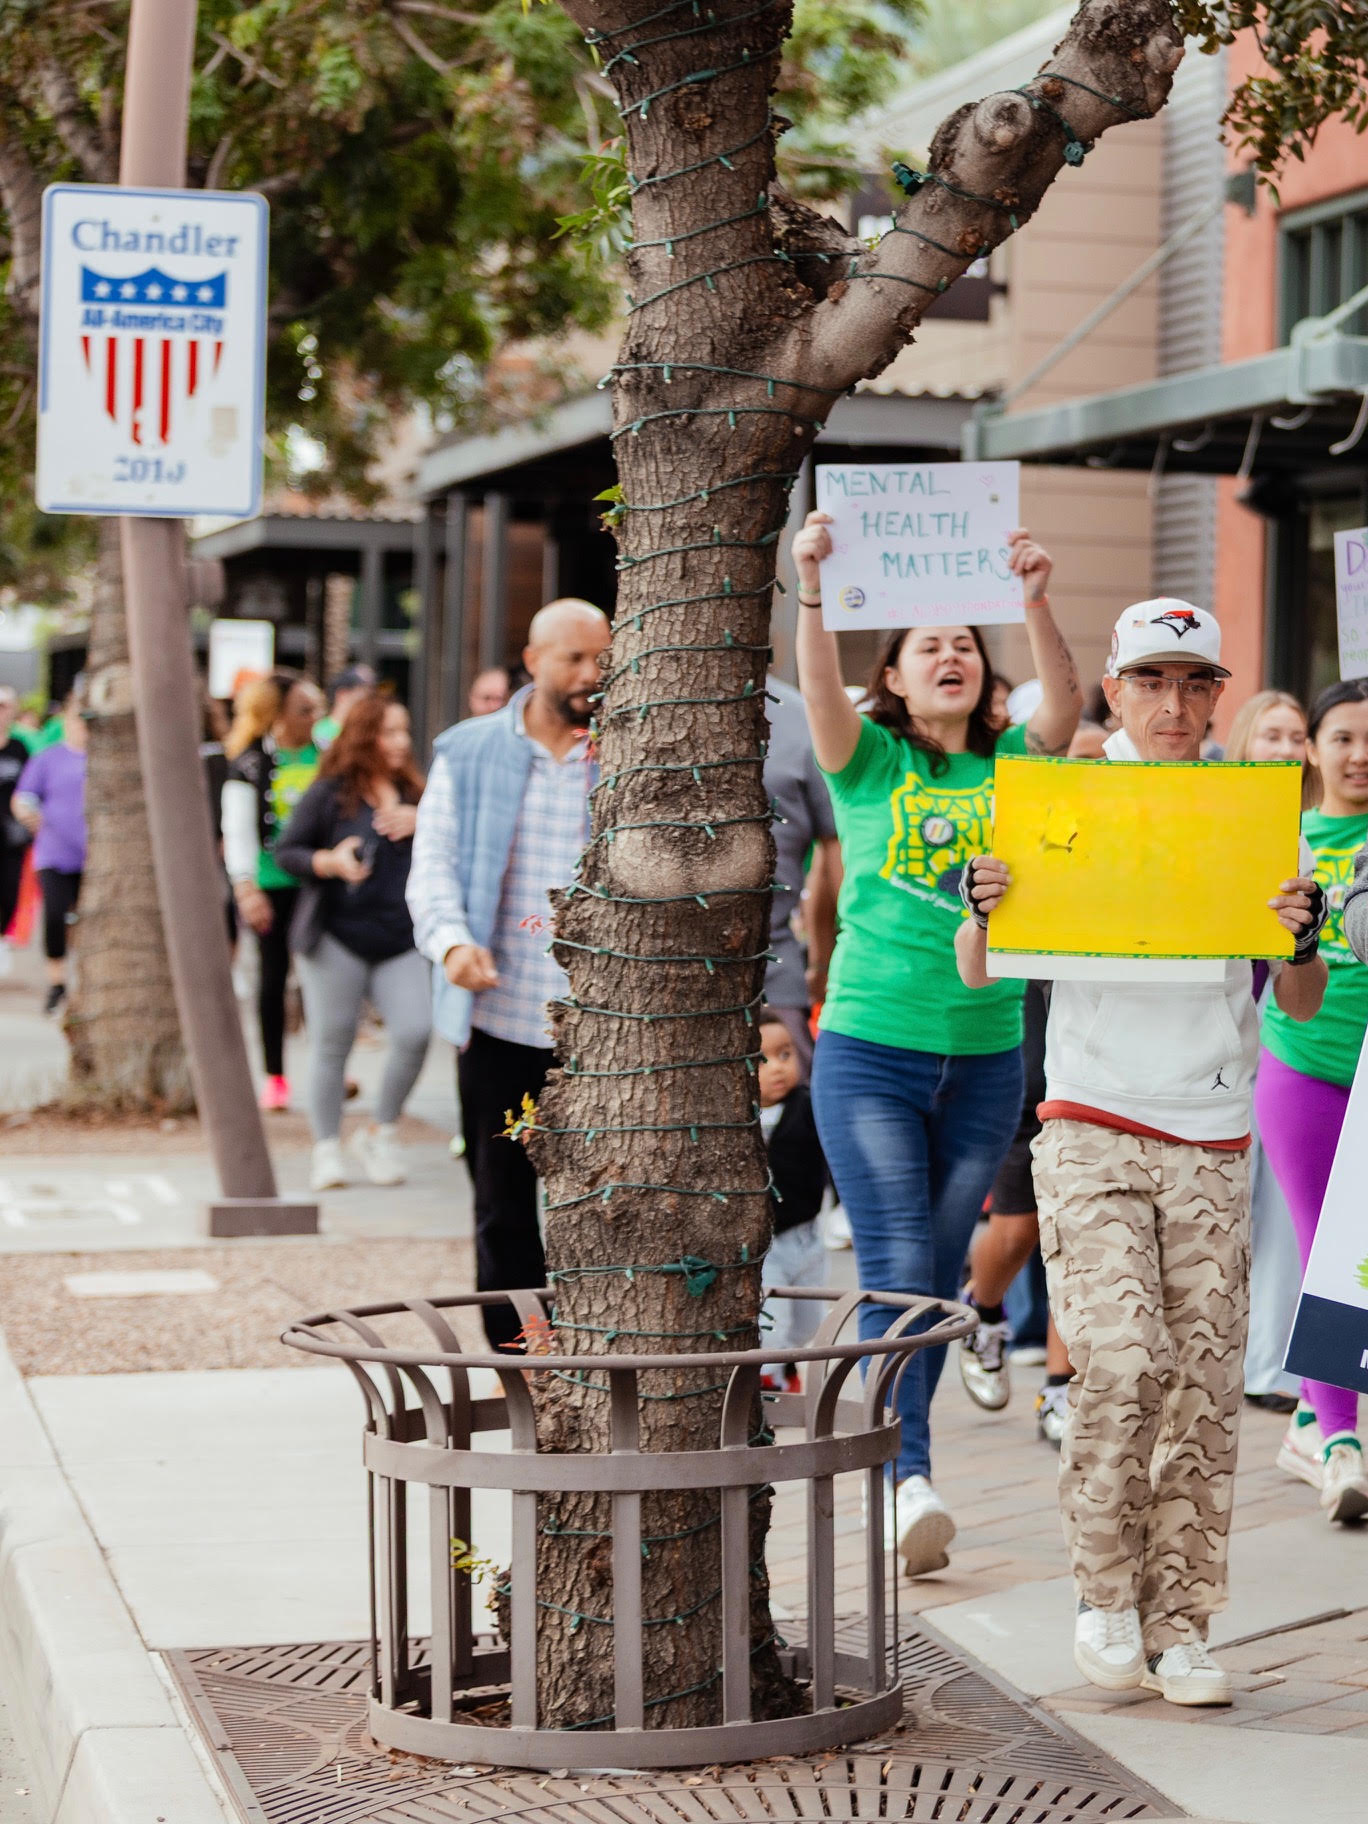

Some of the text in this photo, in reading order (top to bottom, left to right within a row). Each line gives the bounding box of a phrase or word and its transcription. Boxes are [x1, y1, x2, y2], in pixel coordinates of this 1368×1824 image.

[72, 219, 240, 257] Chandler
[82, 309, 224, 336] All-America City
[826, 471, 951, 497] MENTAL
[860, 511, 970, 539] HEALTH
[880, 548, 1012, 581] MATTERS
